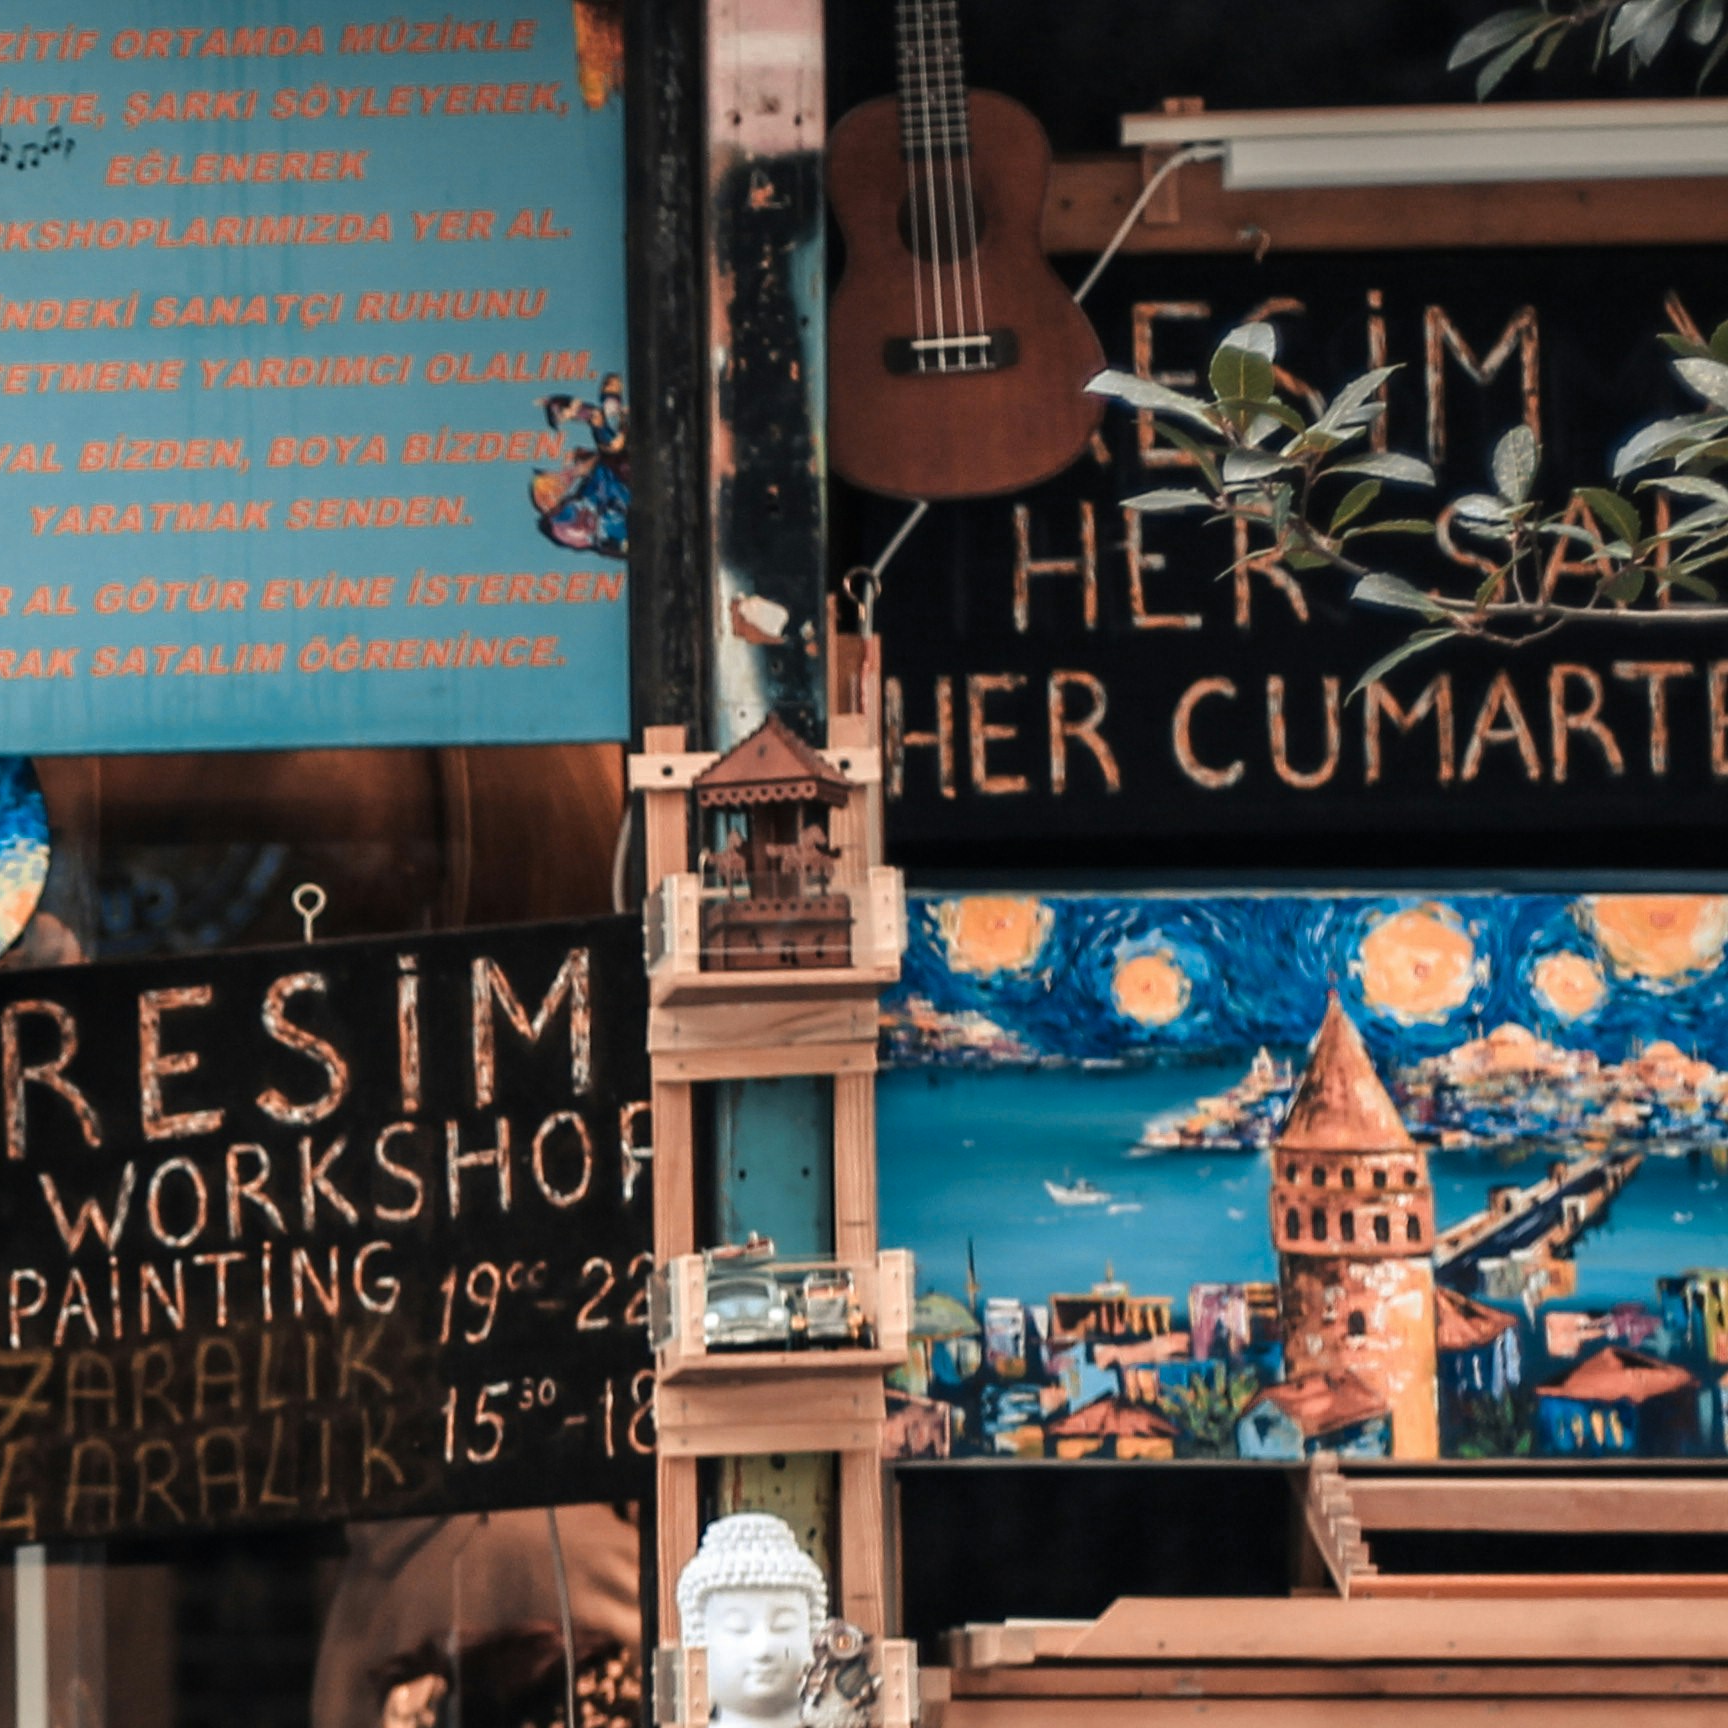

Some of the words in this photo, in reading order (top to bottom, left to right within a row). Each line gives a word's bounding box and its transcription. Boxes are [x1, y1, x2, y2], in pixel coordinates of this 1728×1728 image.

[110, 25, 325, 61] ORTAMDA
[338, 15, 538, 55] MÜZİKLE
[269, 82, 570, 121] SÖYLEYEREK,
[411, 209, 497, 242] YER
[505, 208, 572, 240] AL.
[354, 288, 548, 324] RUHUNU
[199, 353, 414, 390] YARDIMCI
[424, 350, 599, 385] OLALIM.
[76, 433, 251, 475] BİZDEN,
[266, 434, 388, 469] BOYA
[29, 499, 274, 537] YARATMAK
[284, 495, 473, 531] SENDEN.
[21, 584, 79, 617] AL
[93, 575, 250, 615] GÖTÜR
[259, 573, 397, 611] EVİNE
[406, 570, 626, 607] İSTERSEN
[89, 642, 288, 678] SATALIM
[885, 669, 1121, 799] HER
[39, 1099, 653, 1255] WORKSHOP
